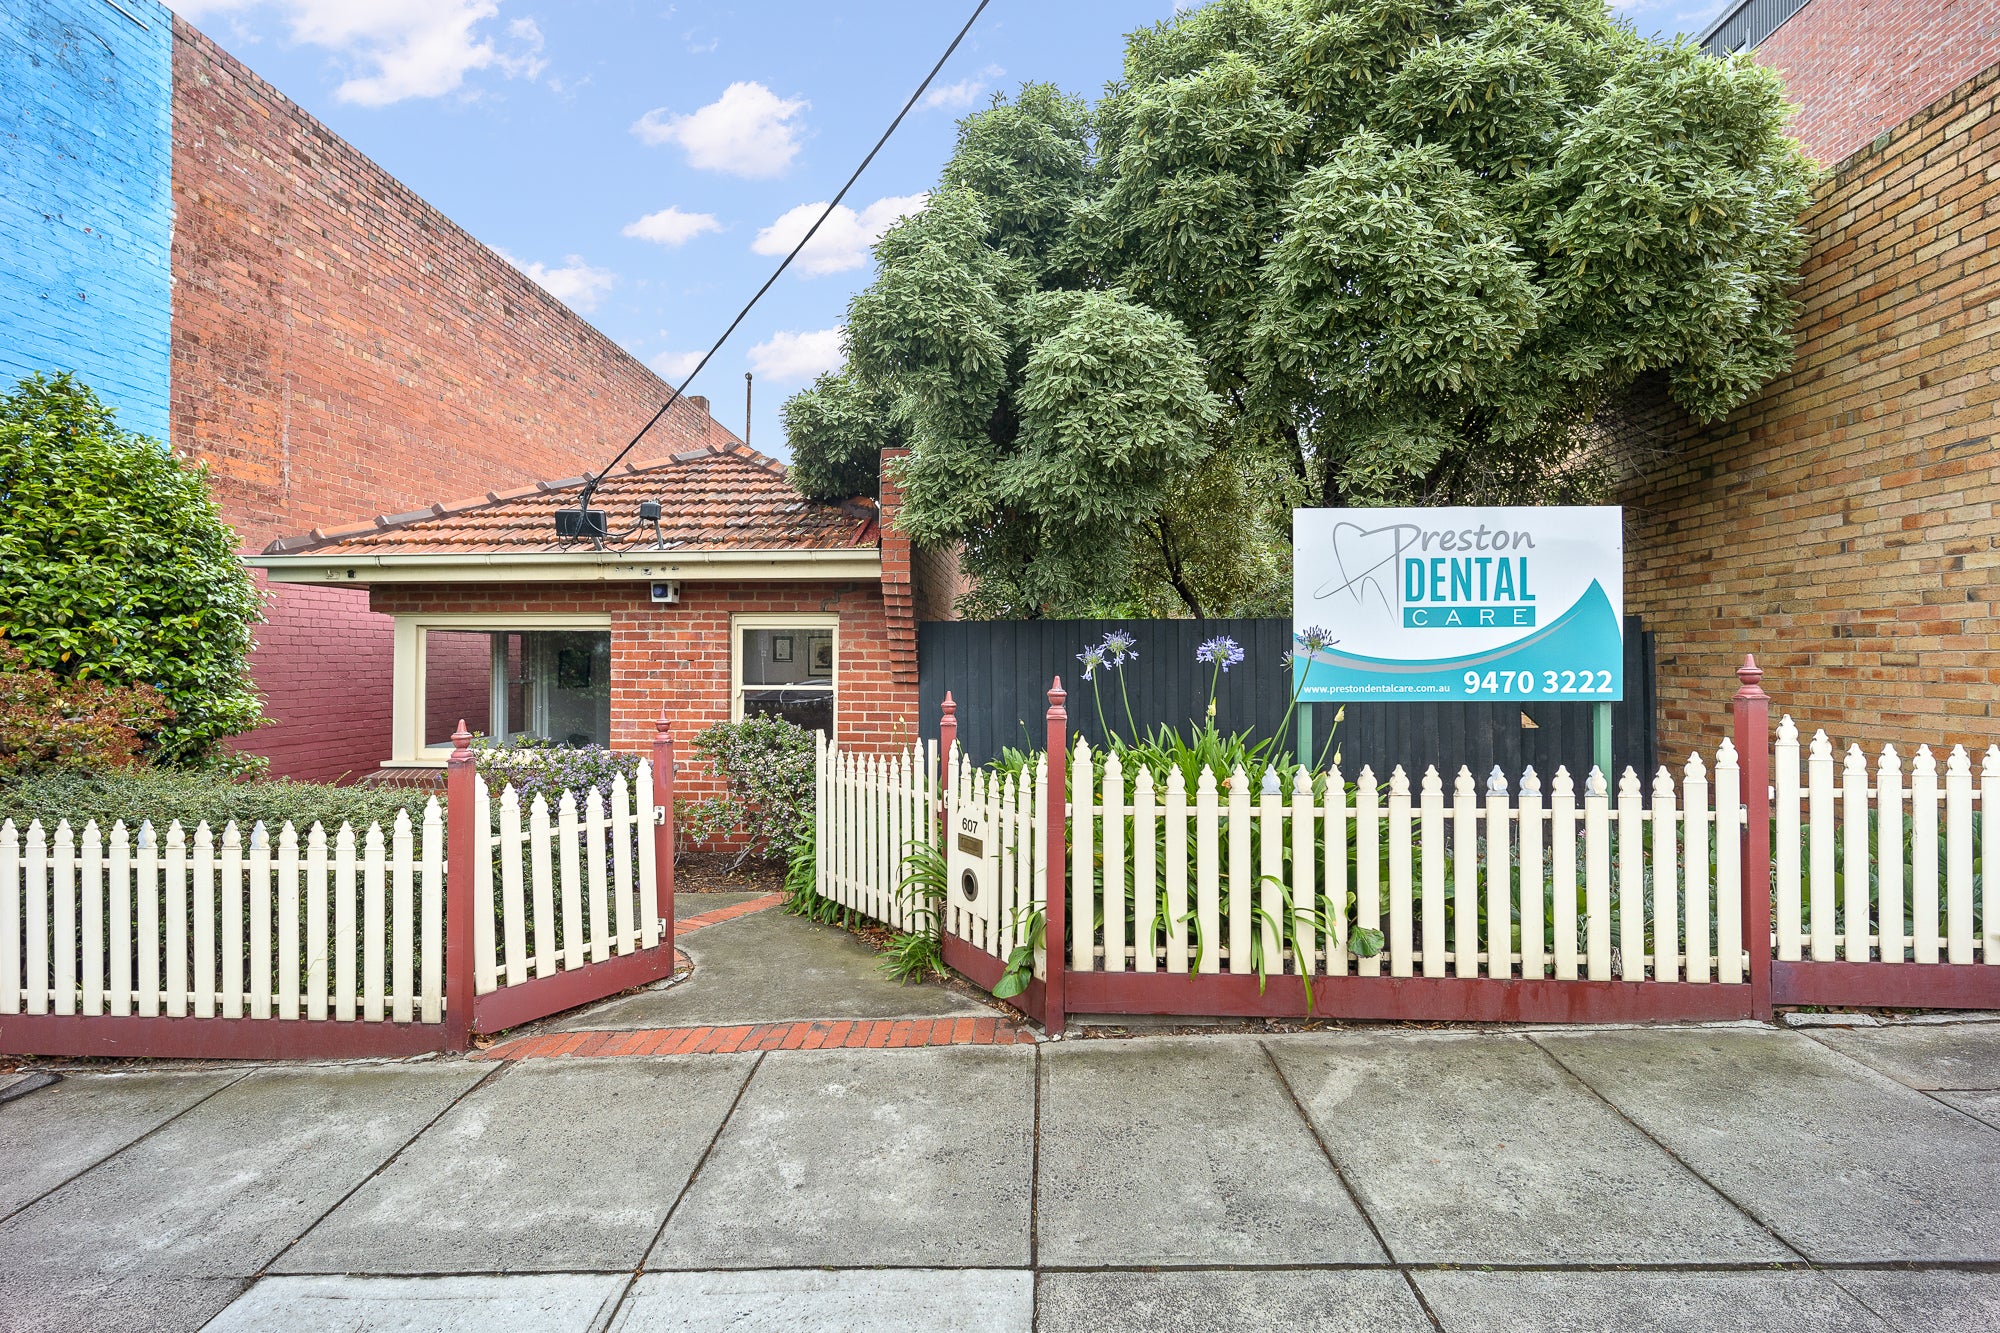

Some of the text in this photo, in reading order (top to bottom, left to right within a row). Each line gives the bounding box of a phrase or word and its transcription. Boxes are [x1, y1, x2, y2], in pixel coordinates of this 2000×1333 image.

[1372, 523, 1536, 566] Preston
[1405, 557, 1536, 602] DENTAL
[1412, 608, 1528, 626] CARE
[1303, 684, 1450, 695] www.prestondentalcare.com.au
[1463, 670, 1613, 694] 9470 3222
[962, 817, 978, 834] 607
